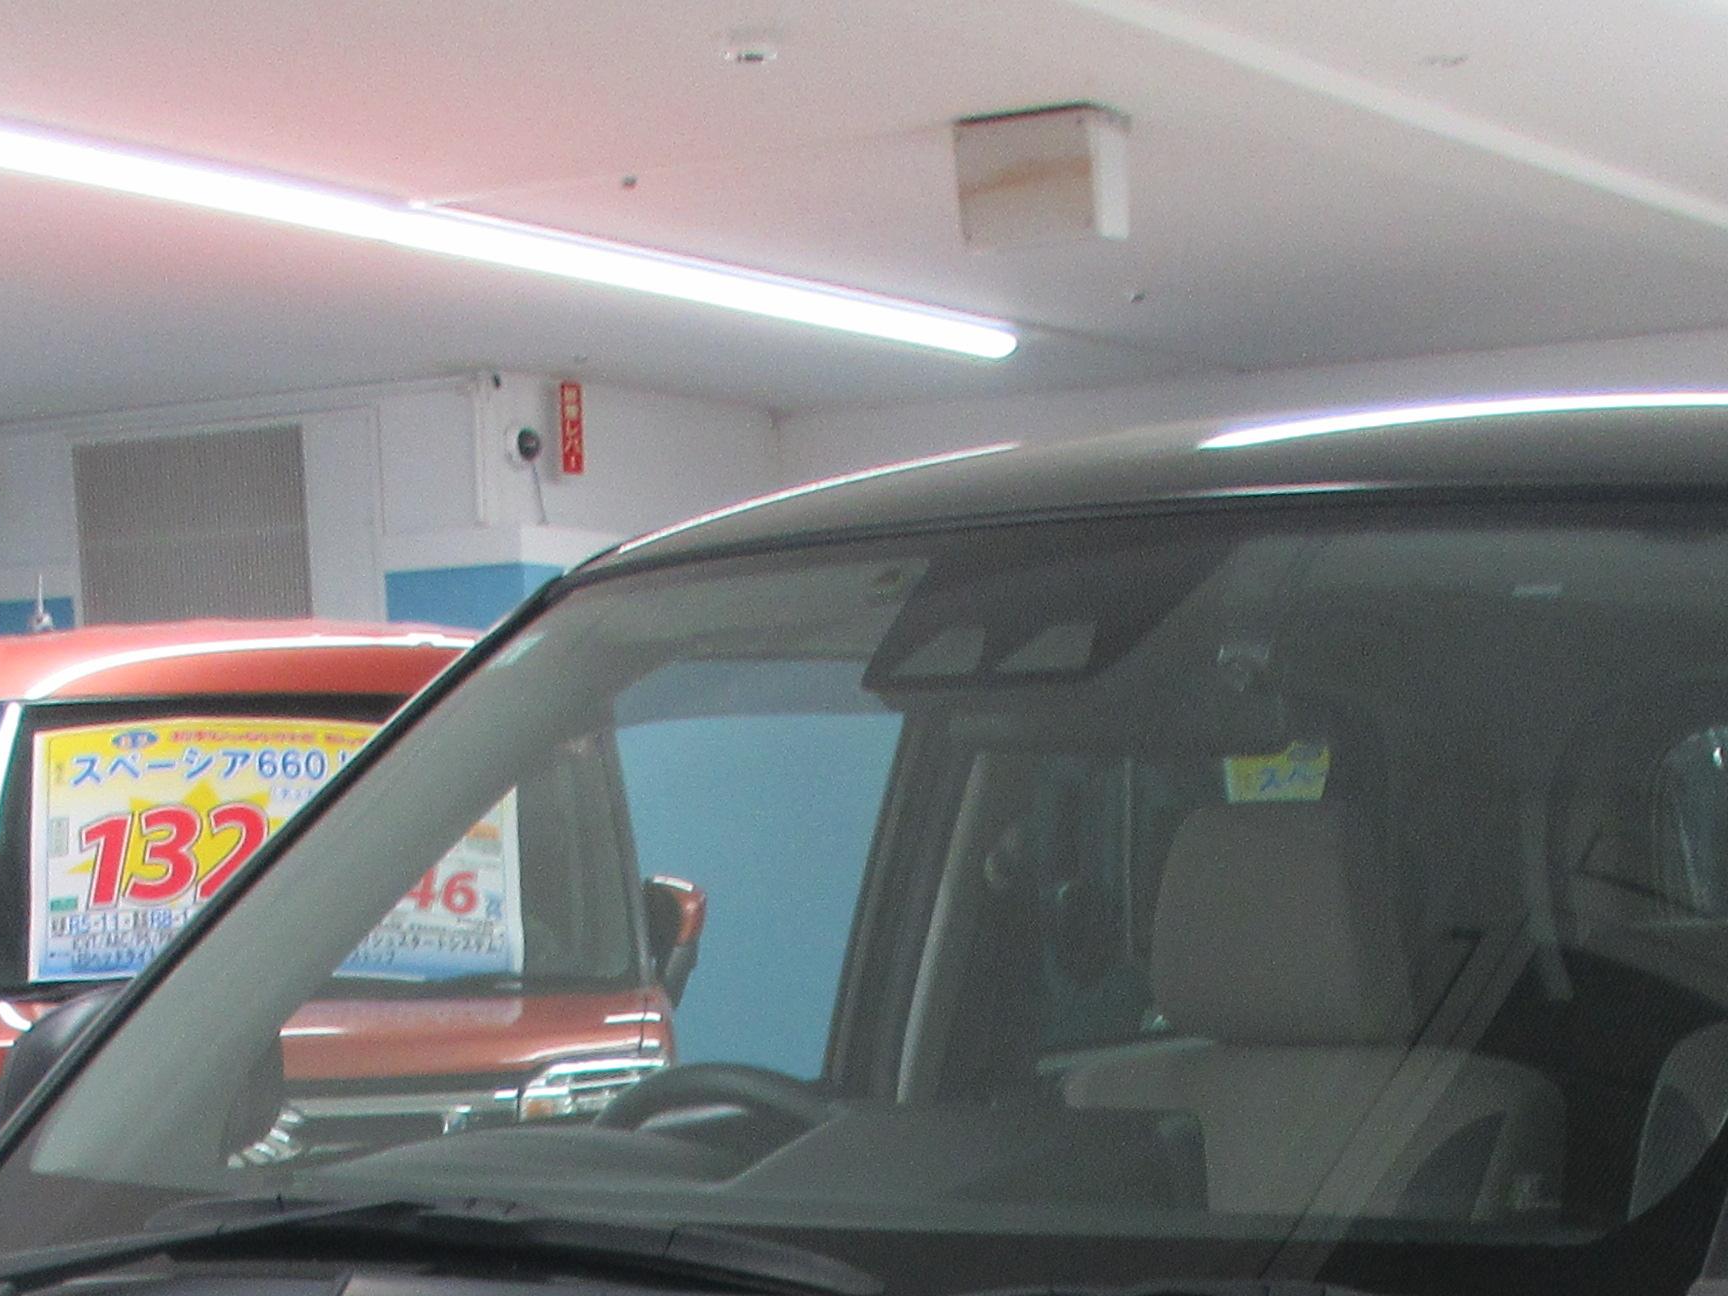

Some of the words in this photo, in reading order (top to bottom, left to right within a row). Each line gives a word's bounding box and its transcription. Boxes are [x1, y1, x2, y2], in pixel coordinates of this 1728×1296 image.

[72, 747, 326, 786] スペーシア660
[81, 803, 269, 908] 132
